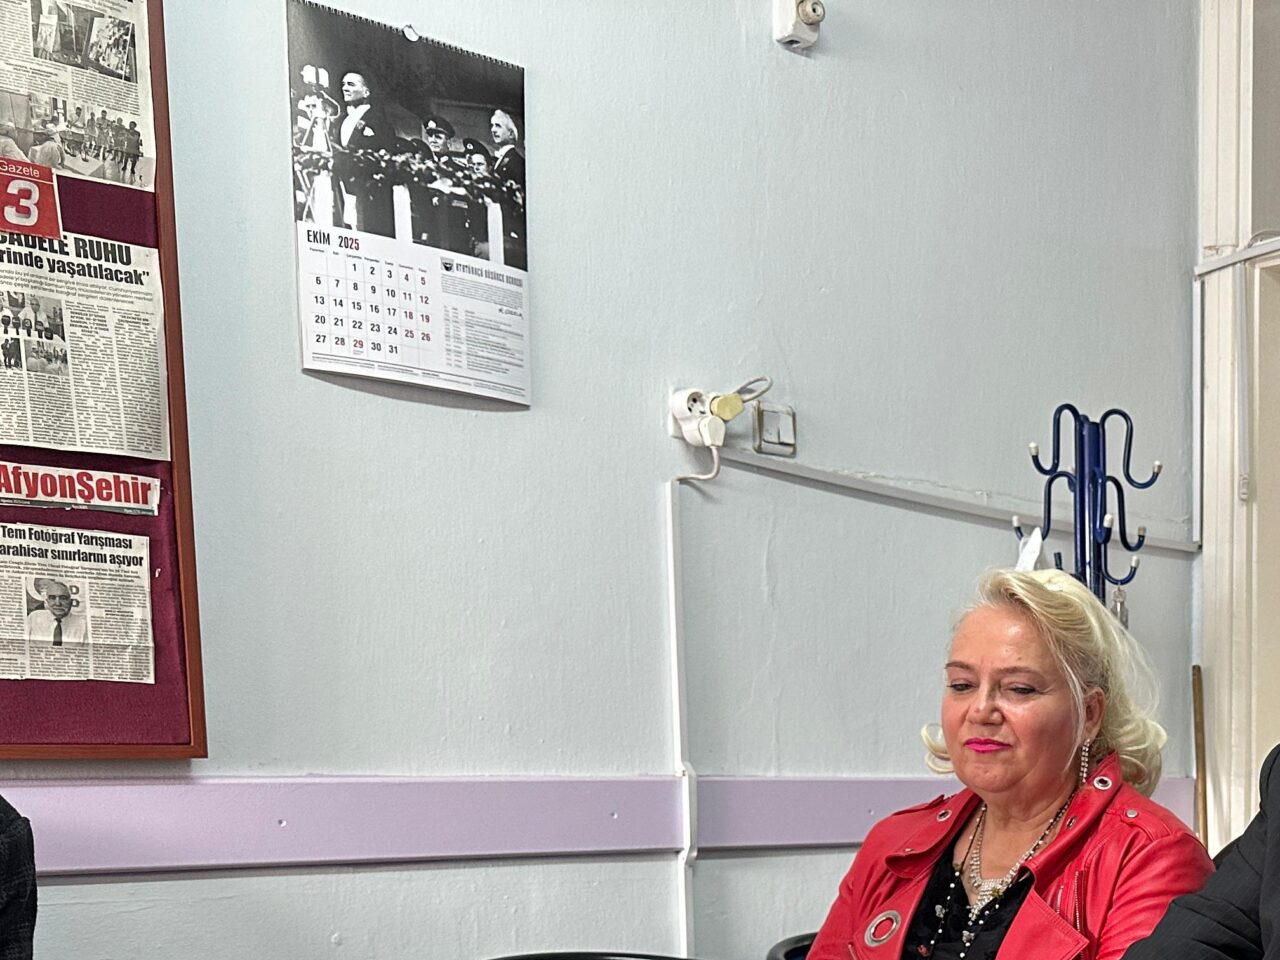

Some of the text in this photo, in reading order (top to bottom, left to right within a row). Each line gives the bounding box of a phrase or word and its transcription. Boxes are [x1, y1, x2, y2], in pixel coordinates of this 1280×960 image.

[0, 160, 40, 178] Gazete
[3, 179, 40, 227] 3
[73, 236, 132, 266] RUHU
[306, 229, 360, 251] EKİM 2025
[352, 264, 426, 286] 1 2 3 4 5
[316, 276, 429, 305] 6 7 8 9 10 11 12
[314, 295, 430, 323] 13 14 15 16 17 18 19
[315, 315, 431, 342] 20 21 22 23 24 25 26
[316, 334, 398, 354] 27 28 29 30 31
[0, 464, 151, 505] AfyonŞehir
[1, 525, 132, 549] Tem Fotoğraf Yarışması
[51, 548, 107, 564] sınırlarını
[109, 553, 144, 568] aşıyor
